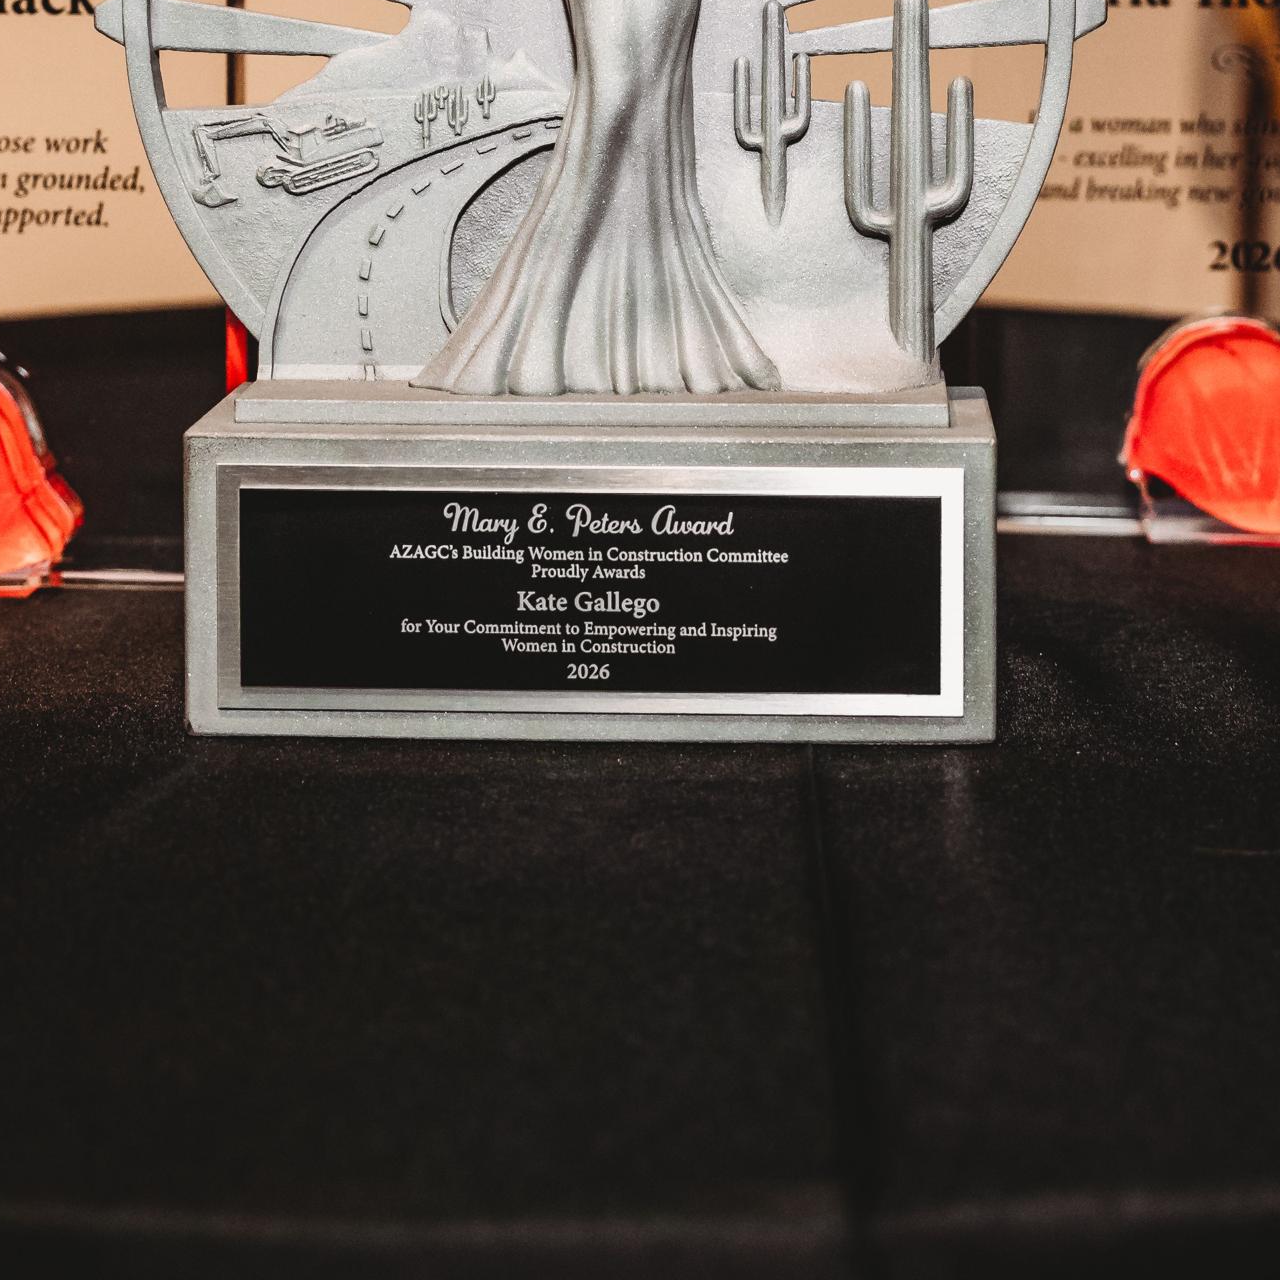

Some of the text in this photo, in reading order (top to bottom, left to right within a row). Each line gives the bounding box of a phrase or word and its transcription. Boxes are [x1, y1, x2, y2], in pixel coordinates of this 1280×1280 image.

[1090, 118, 1172, 135] woman
[44, 128, 109, 155] work
[15, 165, 146, 197] grounded,
[443, 501, 735, 544] Mary E. Peters Award
[389, 544, 789, 564] AZAGC's Building Women in Construction Committee
[531, 564, 646, 582] Proudly Awards
[516, 590, 660, 619] Kate Gallego
[401, 618, 777, 641] for Your Commitment to Empowering and Inspiring
[501, 638, 676, 654] Women in Construction
[566, 663, 611, 680] 2026
